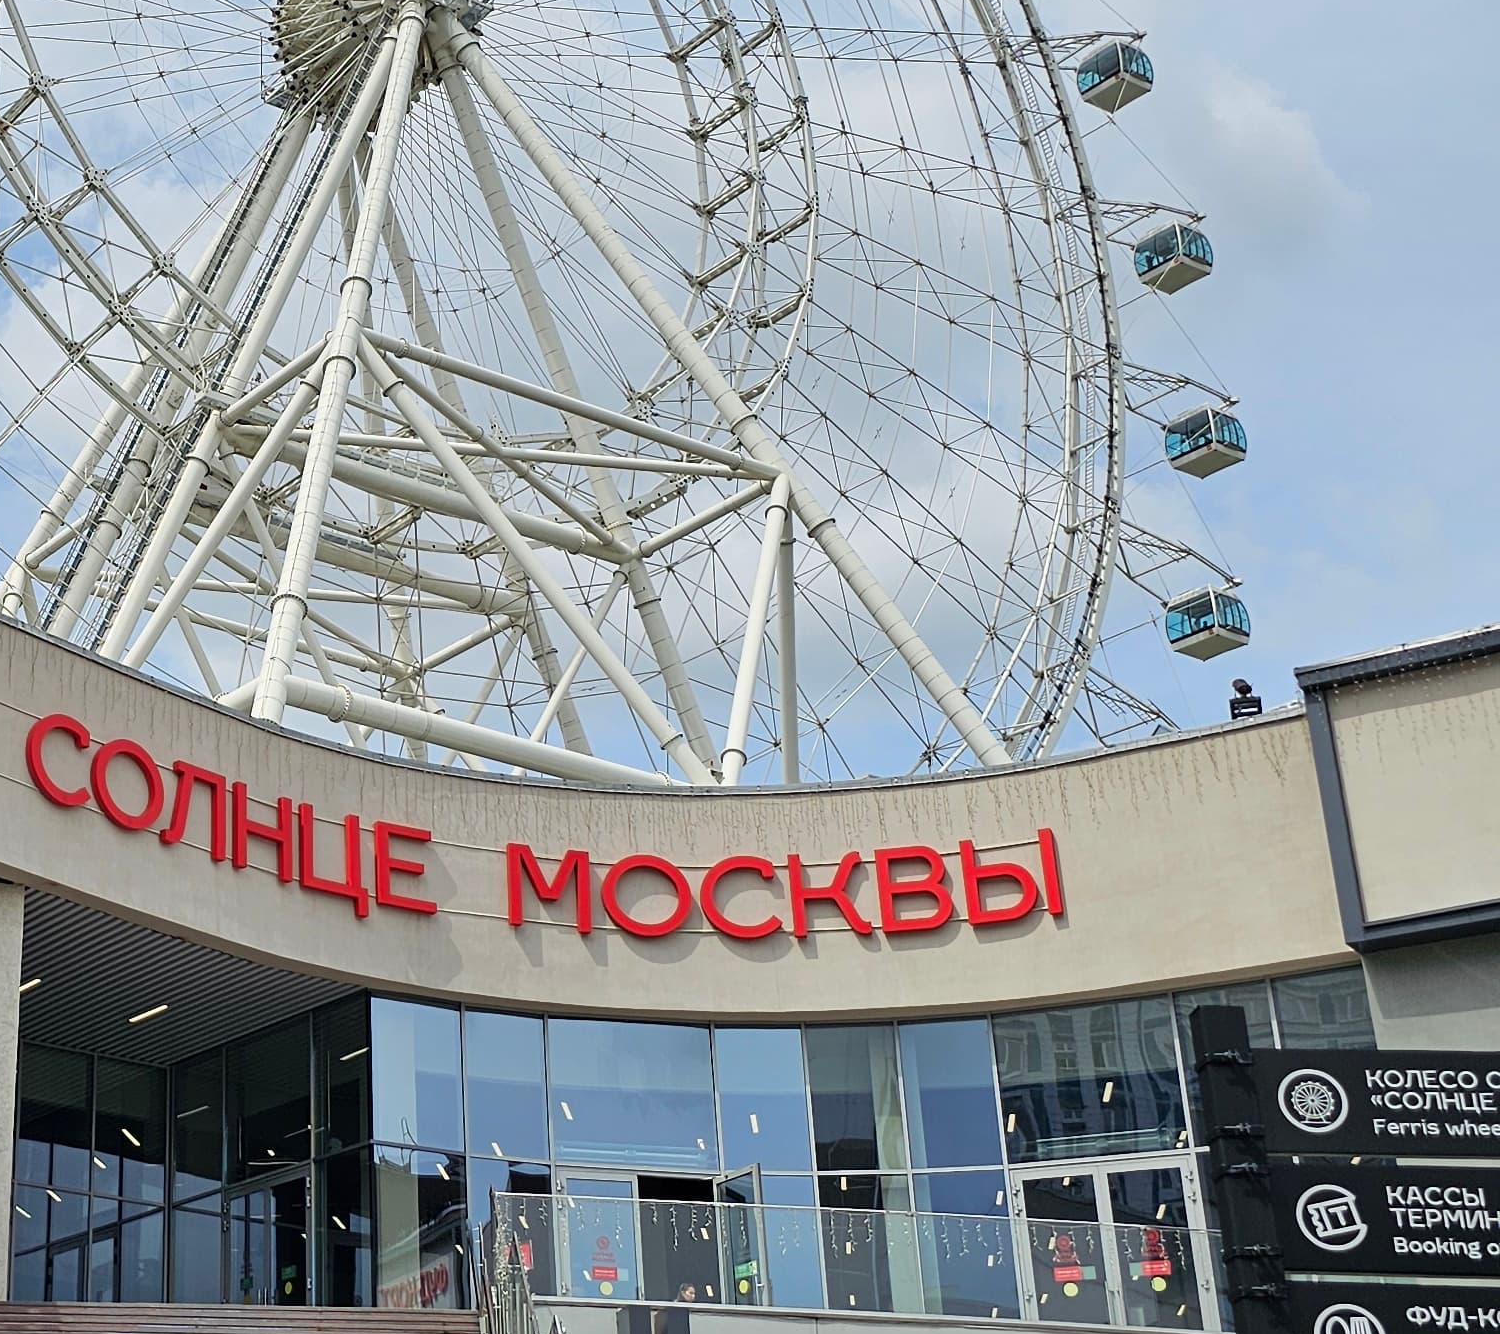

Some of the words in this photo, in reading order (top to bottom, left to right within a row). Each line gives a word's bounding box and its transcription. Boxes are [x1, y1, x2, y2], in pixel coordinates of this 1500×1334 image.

[26, 714, 438, 918] СОЛНЦЕ
[506, 828, 1063, 939] МОСКВЫ
[1365, 1069, 1478, 1089] КОЛЕСО
[1370, 1090, 1498, 1115] «СОЛНЦЕ
[1372, 1118, 1441, 1136] Ferris
[1385, 1185, 1486, 1207] КАССЫ
[1393, 1236, 1483, 1260] Booking
[1405, 1305, 1500, 1331] ФУД-К
